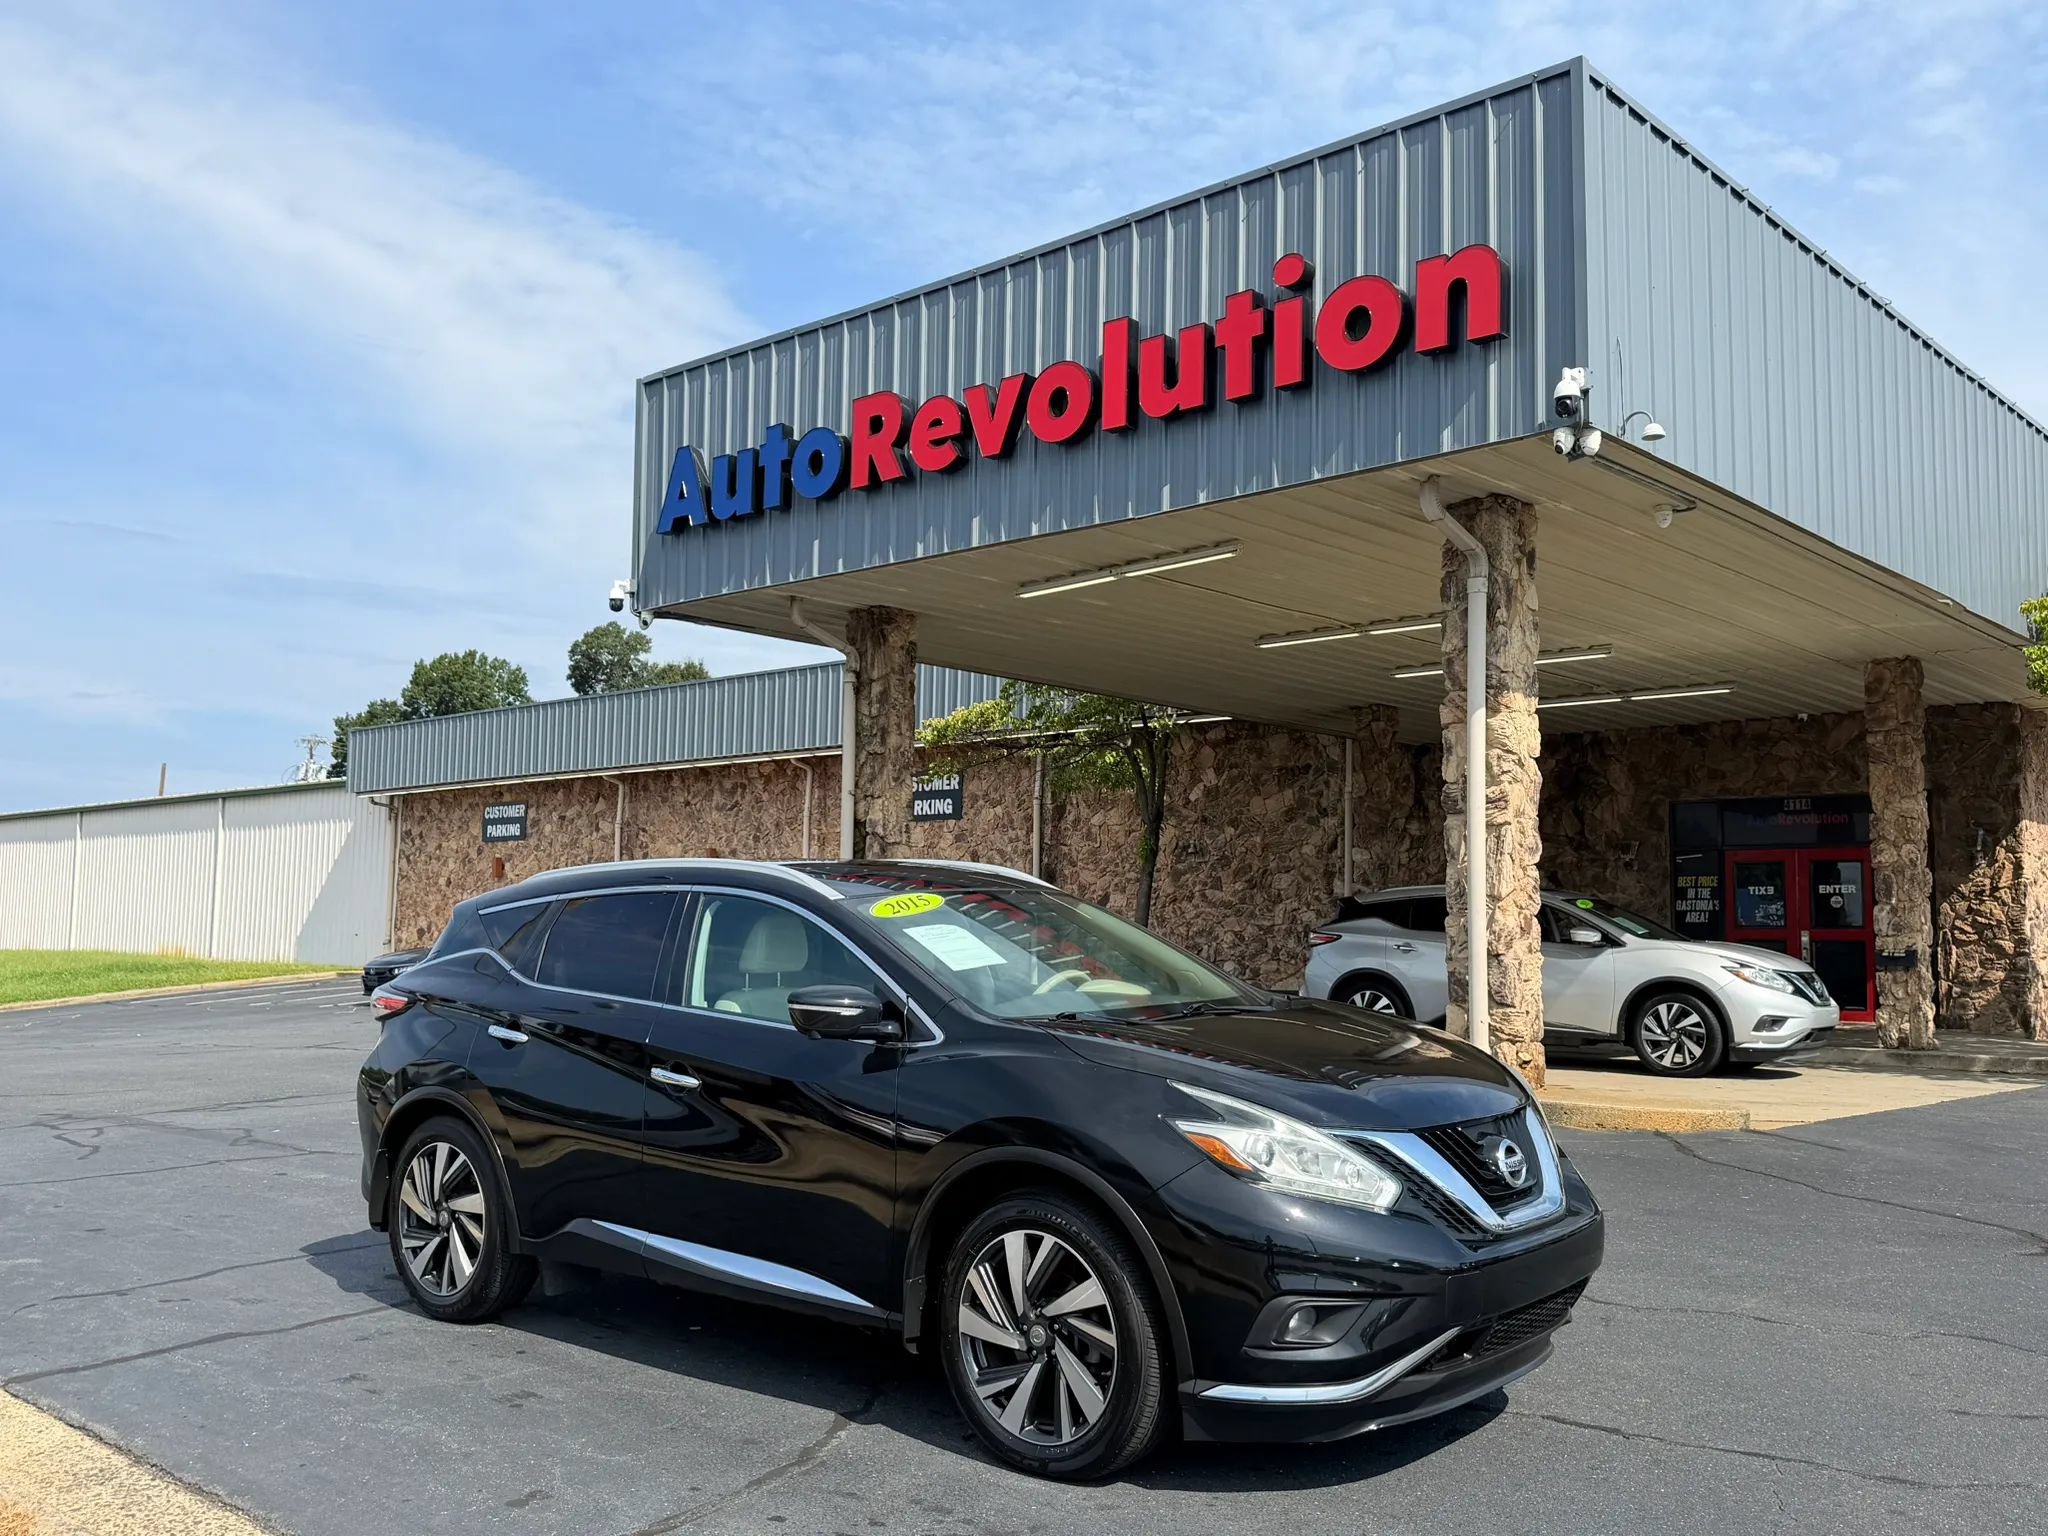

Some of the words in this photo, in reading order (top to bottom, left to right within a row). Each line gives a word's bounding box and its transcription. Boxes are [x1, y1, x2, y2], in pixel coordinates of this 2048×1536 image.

[656, 244, 1509, 534] AutoRevolution
[912, 773, 960, 792] STOMER
[484, 804, 525, 819] CUSTOMER
[913, 798, 953, 816] RKING
[487, 823, 520, 838] PARKING
[1677, 875, 1697, 888] BEST
[1698, 875, 1719, 888] PRICE
[1687, 888, 1696, 899] IN
[1697, 888, 1712, 899] THE
[1818, 884, 1856, 895] ENTER
[884, 895, 931, 915] 2015
[1675, 899, 1720, 911] GASTONIA'S
[1685, 911, 1709, 923] AREA!
